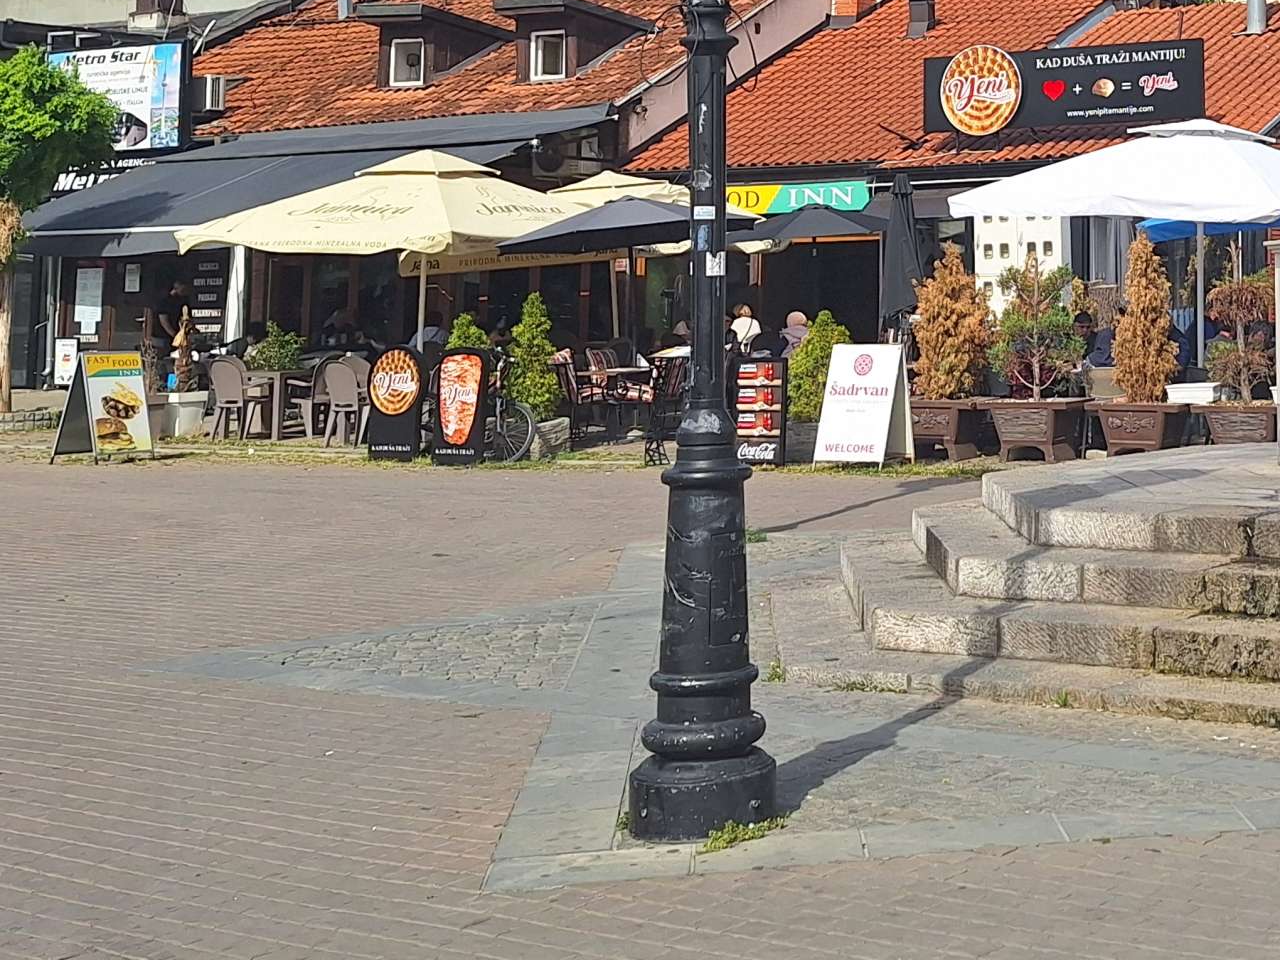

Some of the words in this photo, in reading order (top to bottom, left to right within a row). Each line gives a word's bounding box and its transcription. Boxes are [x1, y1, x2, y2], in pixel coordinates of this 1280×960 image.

[63, 52, 106, 66] Metro
[110, 50, 141, 62] Star
[1036, 57, 1061, 69] KAD
[1062, 54, 1093, 67] DUŠA
[1095, 50, 1130, 64] TRAŽI
[1132, 48, 1186, 62] MANTIJU!
[947, 72, 1006, 112] Yeni
[1139, 72, 1175, 96] Yeni
[727, 191, 760, 208] OD
[788, 186, 854, 207] INN
[87, 355, 111, 365] FAST
[112, 359, 139, 367] FOOD
[829, 381, 889, 397] Šadrvan
[825, 443, 875, 454] WELCOME
